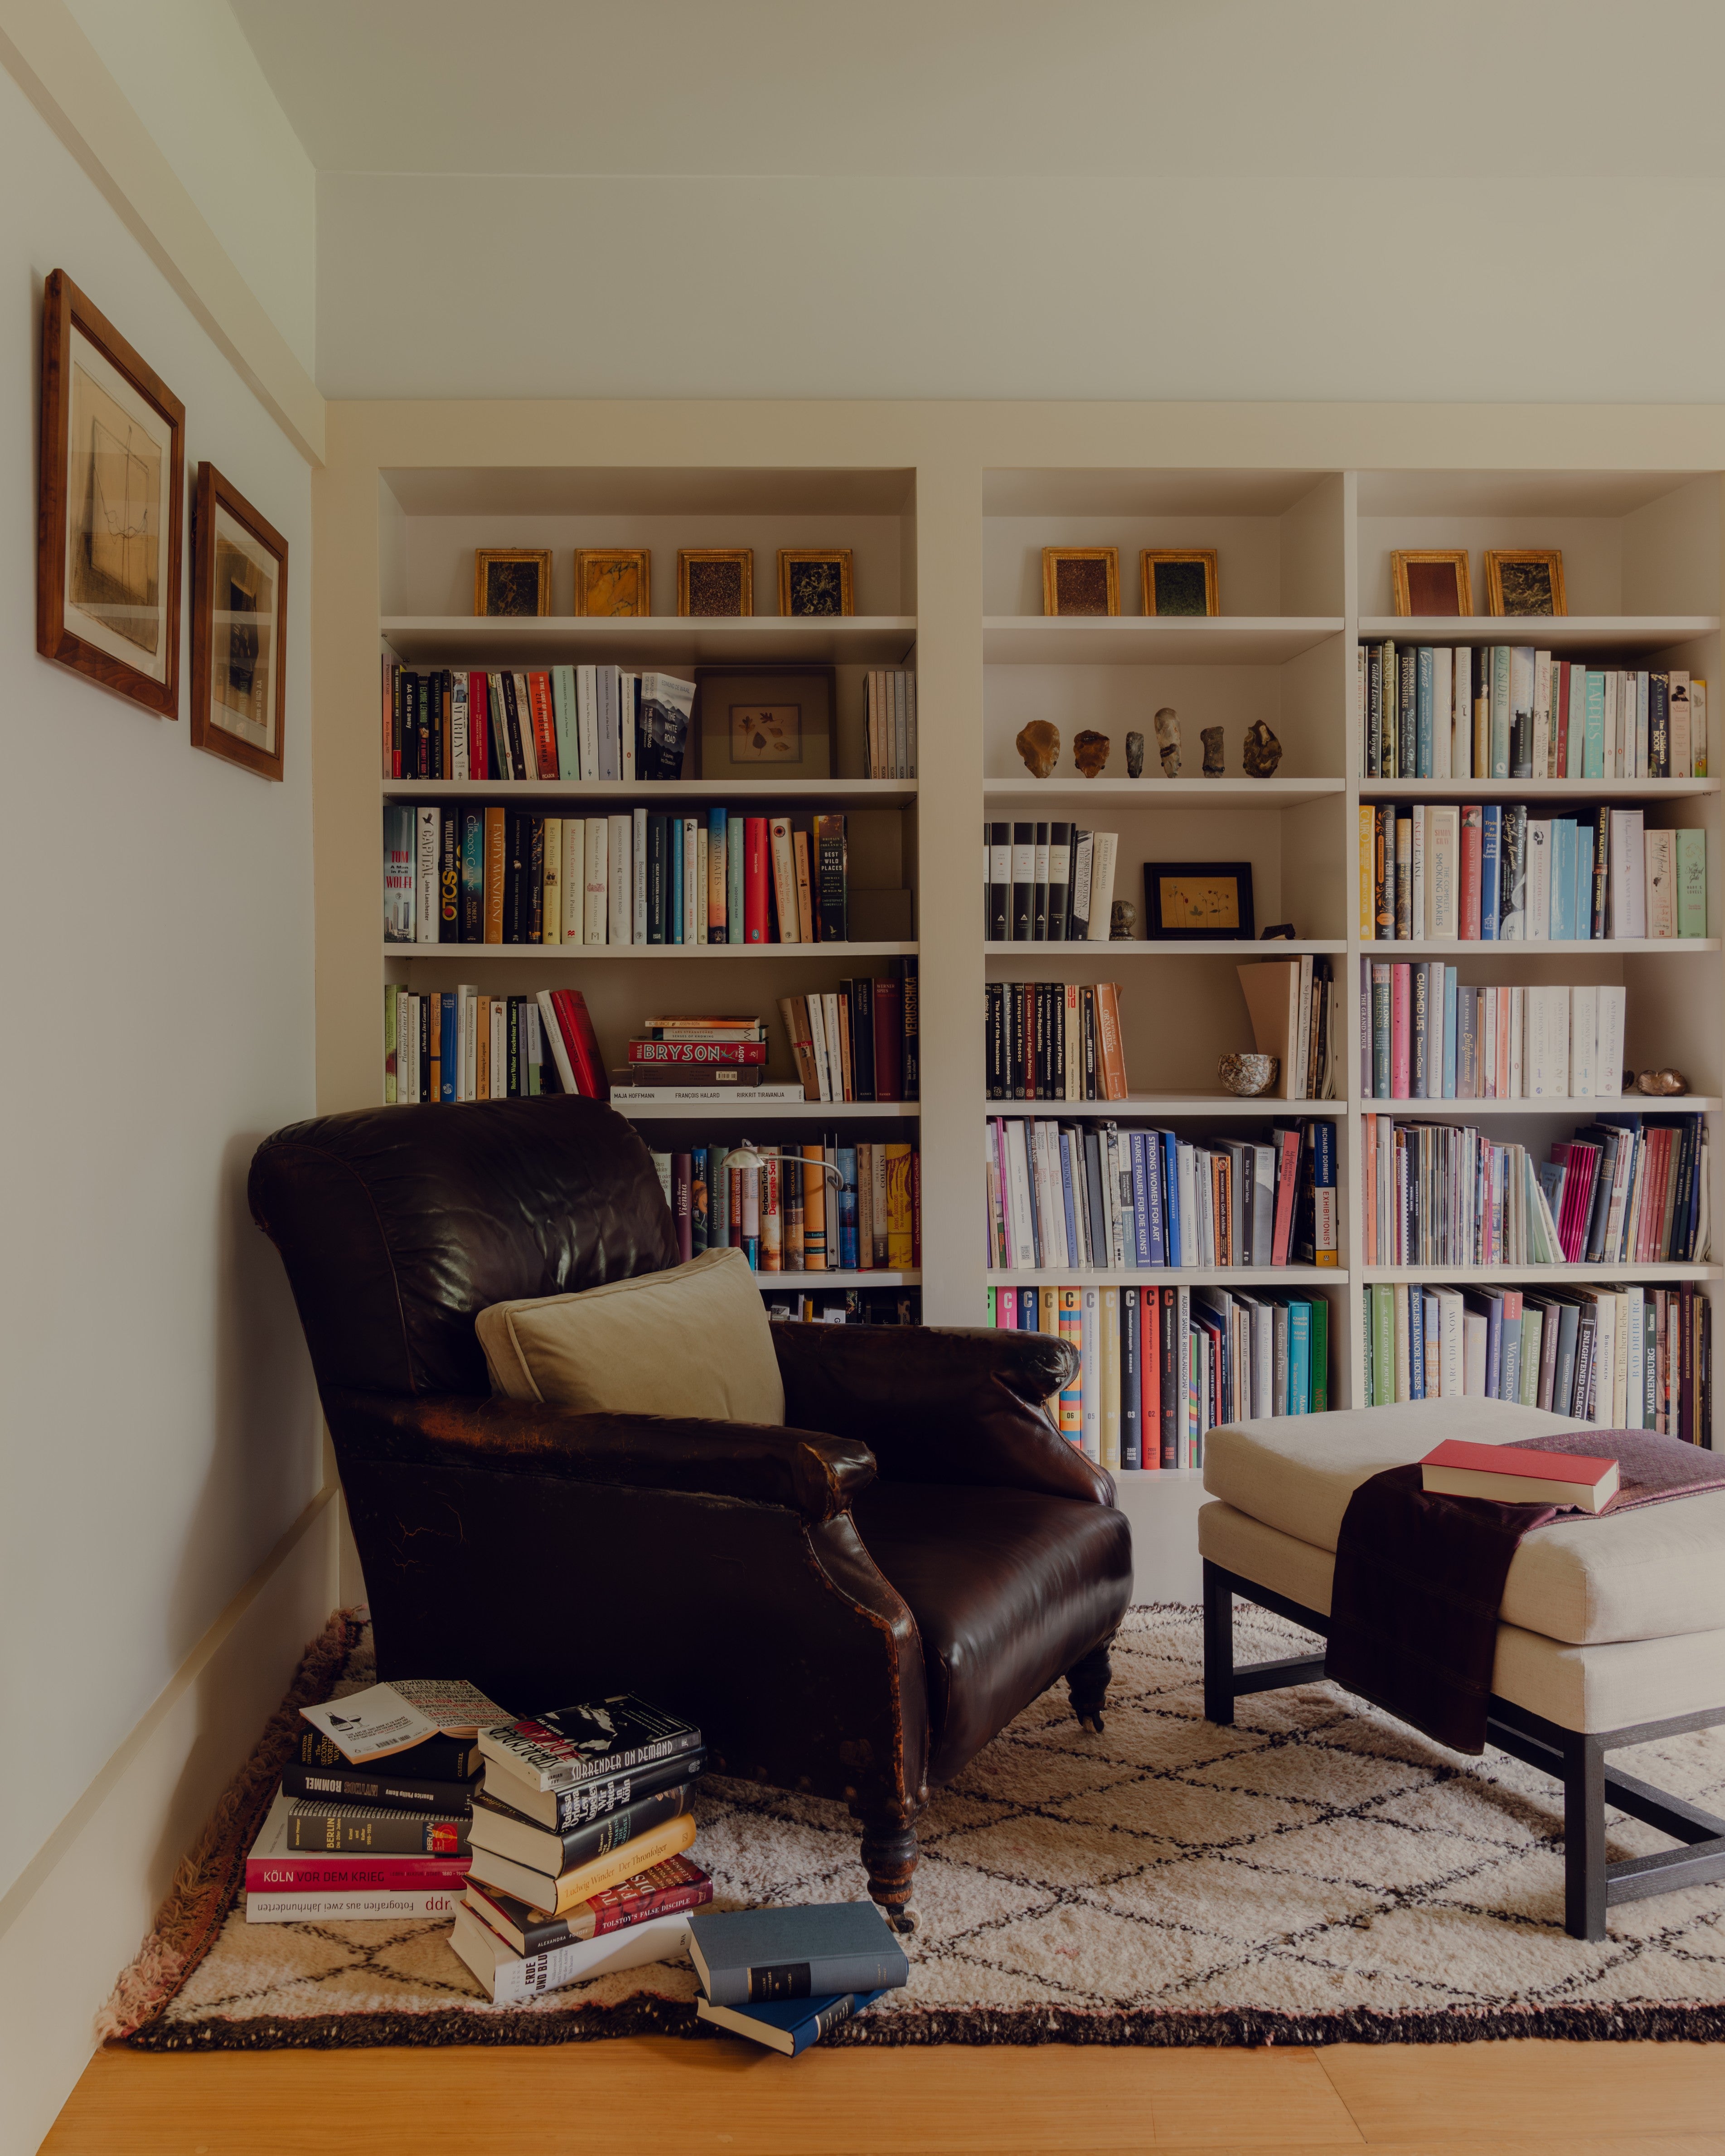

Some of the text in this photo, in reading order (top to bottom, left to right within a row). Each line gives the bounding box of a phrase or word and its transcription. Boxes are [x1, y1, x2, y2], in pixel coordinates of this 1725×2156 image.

[407, 684, 412, 693] AA
[1497, 650, 1507, 706] OUTSIDER
[1588, 675, 1603, 740] FLAPPERS
[454, 705, 463, 758] MARILYN
[392, 851, 409, 863] TOM
[422, 830, 434, 878] CAPITAL
[445, 820, 453, 871] WILLIAM BOYD
[713, 827, 722, 885] EXPATRIATES
[492, 824, 502, 923] EMPTY MANSIONS
[441, 870, 457, 921] SOLO
[1416, 973, 1425, 1030] CHARMED LIFE
[1103, 1010, 1113, 1053] ORNAMENT
[644, 1044, 720, 1061] BRYSON
[1462, 1033, 1473, 1083] Enlightenment
[1134, 1136, 1142, 1164] STARKE
[1148, 1136, 1156, 1170] STRONG
[1135, 1165, 1144, 1195] FRAUEN
[1149, 1172, 1158, 1205] WOMEN
[678, 1184, 688, 1216] Vienna
[1136, 1196, 1145, 1213] FÜR
[1139, 1229, 1147, 1255] KUNST
[572, 1740, 673, 1781] SURRENDER ON DEMAND
[305, 1777, 342, 1793] ROMMEL
[386, 1789, 434, 1801] Maurice Philip Remy
[597, 1790, 607, 1811] Wir
[605, 1781, 615, 1812] lebten
[615, 1789, 622, 1800] in
[621, 1779, 630, 1804] Köln
[562, 1794, 572, 1829] Raissa
[570, 1790, 580, 1827] Orlowa
[579, 1797, 588, 1818] Lew
[264, 1870, 384, 1882] KÖLN VOR DEM KRIEG
[565, 1844, 667, 1898] Ludwig Winder Der Thronfolger
[258, 1903, 321, 1912] Jahrhunderten
[325, 1903, 343, 1912] zwei
[364, 1902, 414, 1913] Fotografien
[602, 1898, 690, 1929] TOLSTOY'S FALSE DISCIPLE
[525, 1962, 536, 1986] ERDE
